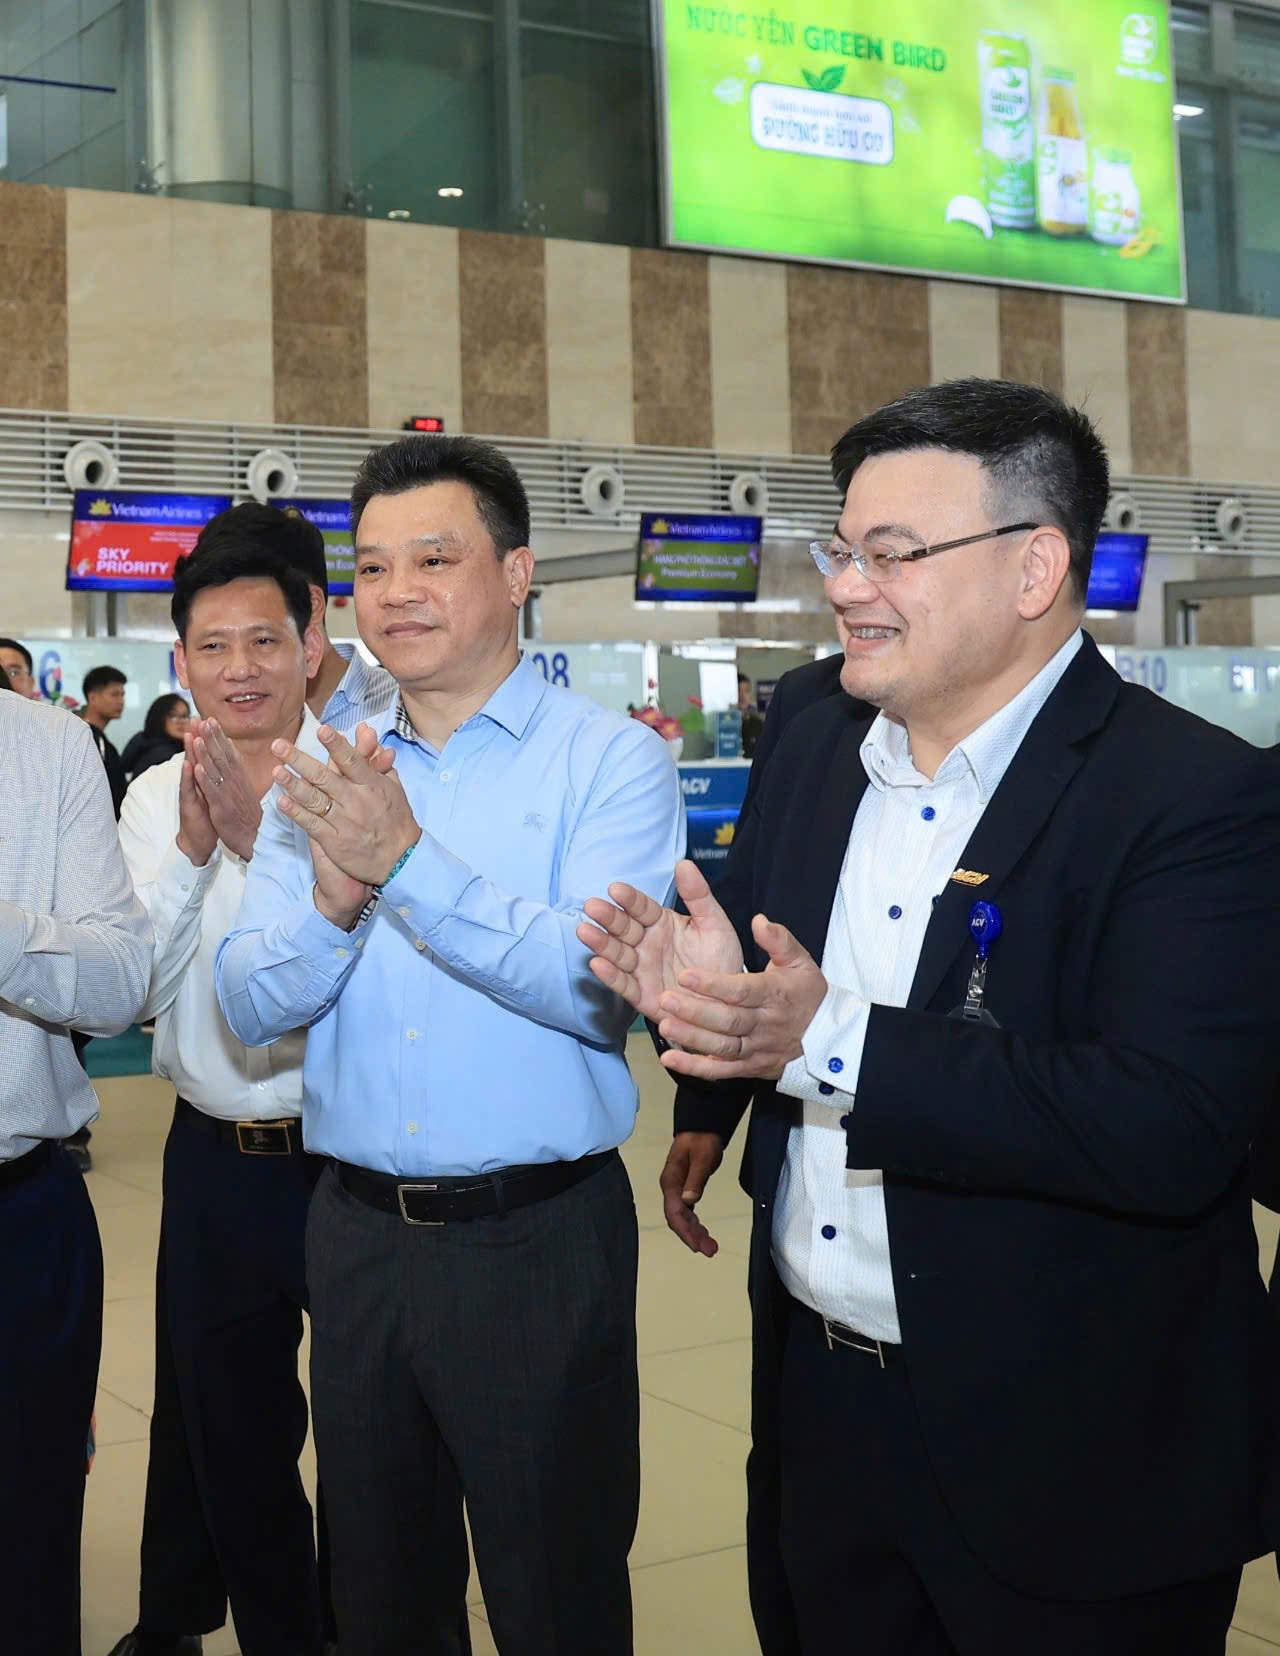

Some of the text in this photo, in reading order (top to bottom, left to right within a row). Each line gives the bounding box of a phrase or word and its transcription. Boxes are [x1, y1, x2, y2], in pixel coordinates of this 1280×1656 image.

[803, 26, 883, 60] GREEN
[892, 42, 946, 72] BIRD
[98, 547, 130, 561] SKY
[96, 560, 168, 575] PRIORITY
[972, 918, 985, 927] ACV
